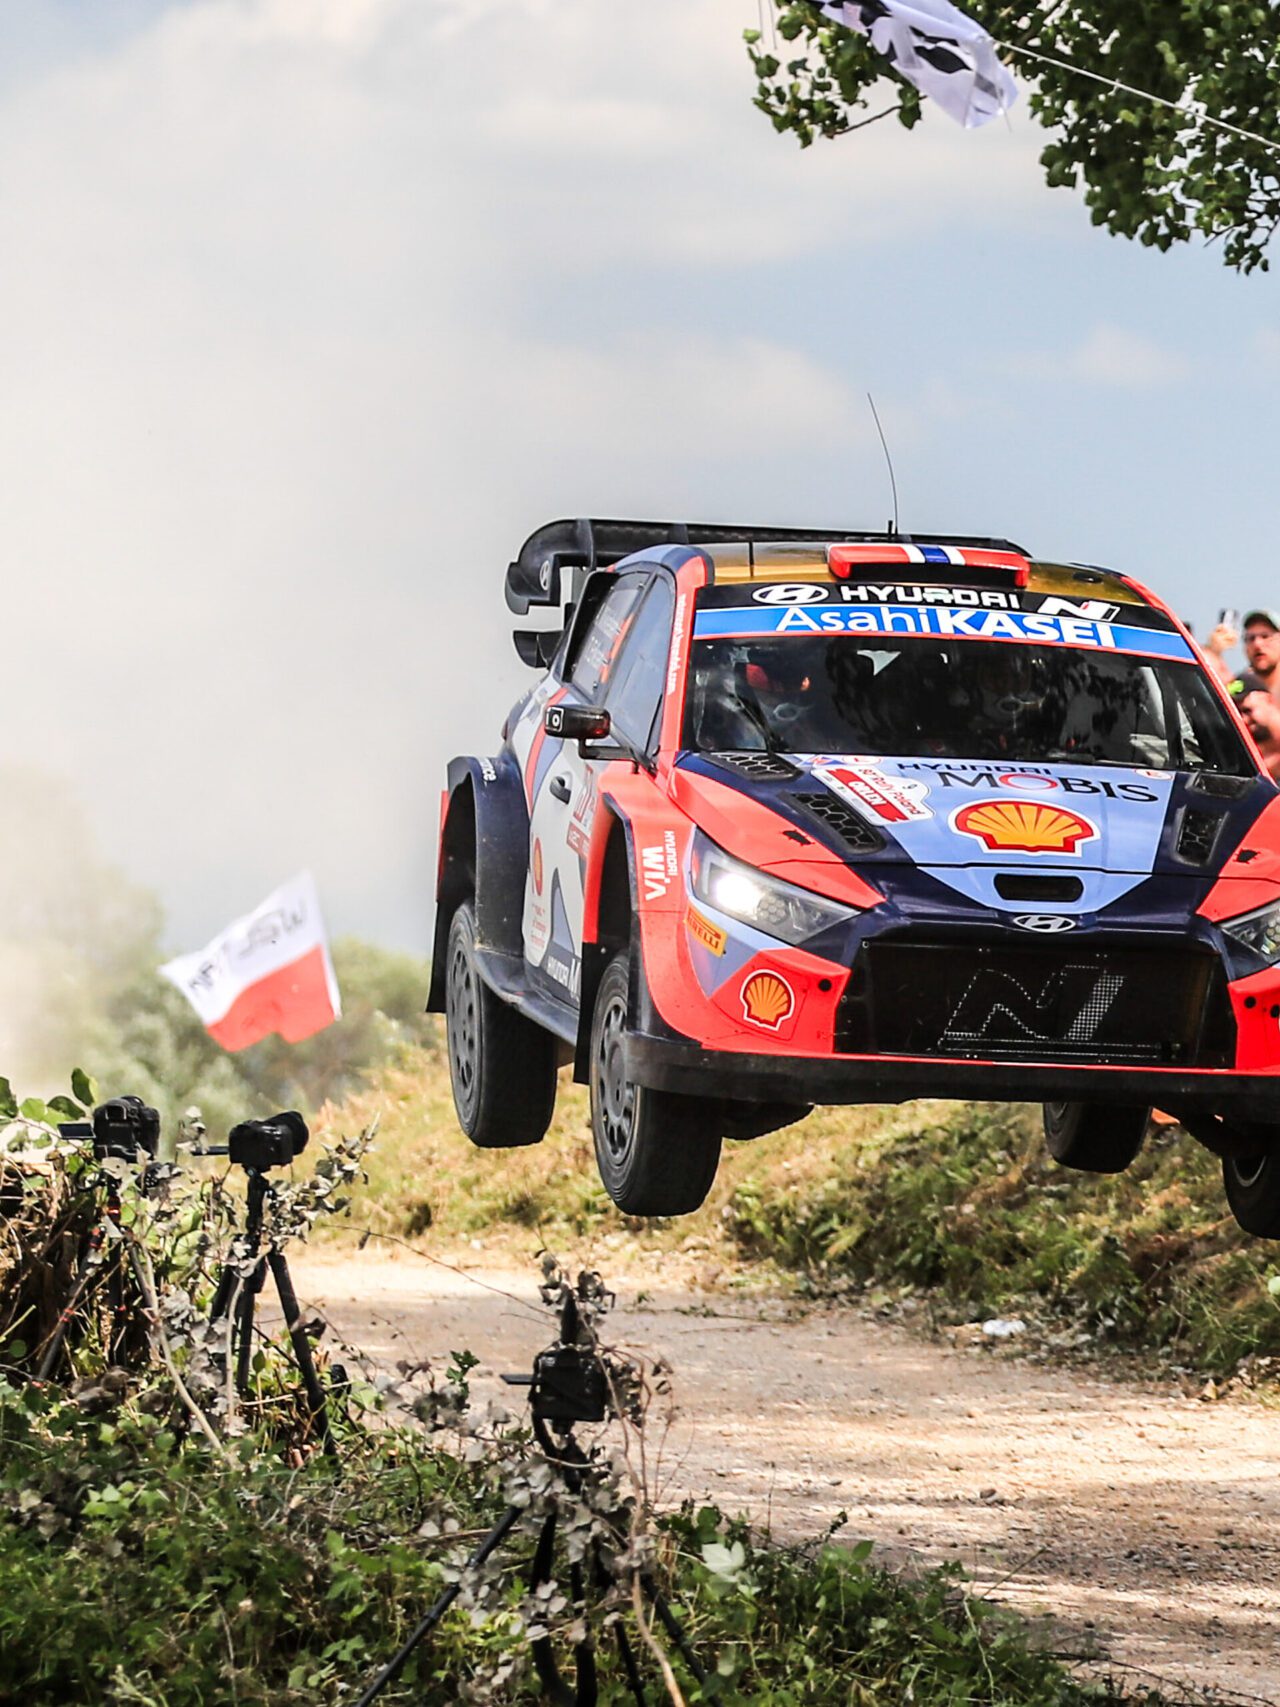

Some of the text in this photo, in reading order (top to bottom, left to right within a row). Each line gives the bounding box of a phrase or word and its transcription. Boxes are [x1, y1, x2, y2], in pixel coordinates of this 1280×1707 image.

[842, 585, 1020, 609] HYUNDAI
[775, 608, 1116, 648] AsahiKASEI
[897, 763, 1052, 775] HYUNDAI
[847, 781, 888, 805] ORLEN
[937, 772, 1159, 803] MOBIS
[664, 830, 678, 876] HYUNDAI
[641, 845, 671, 901] WIA
[687, 907, 722, 950] PIRELLI
